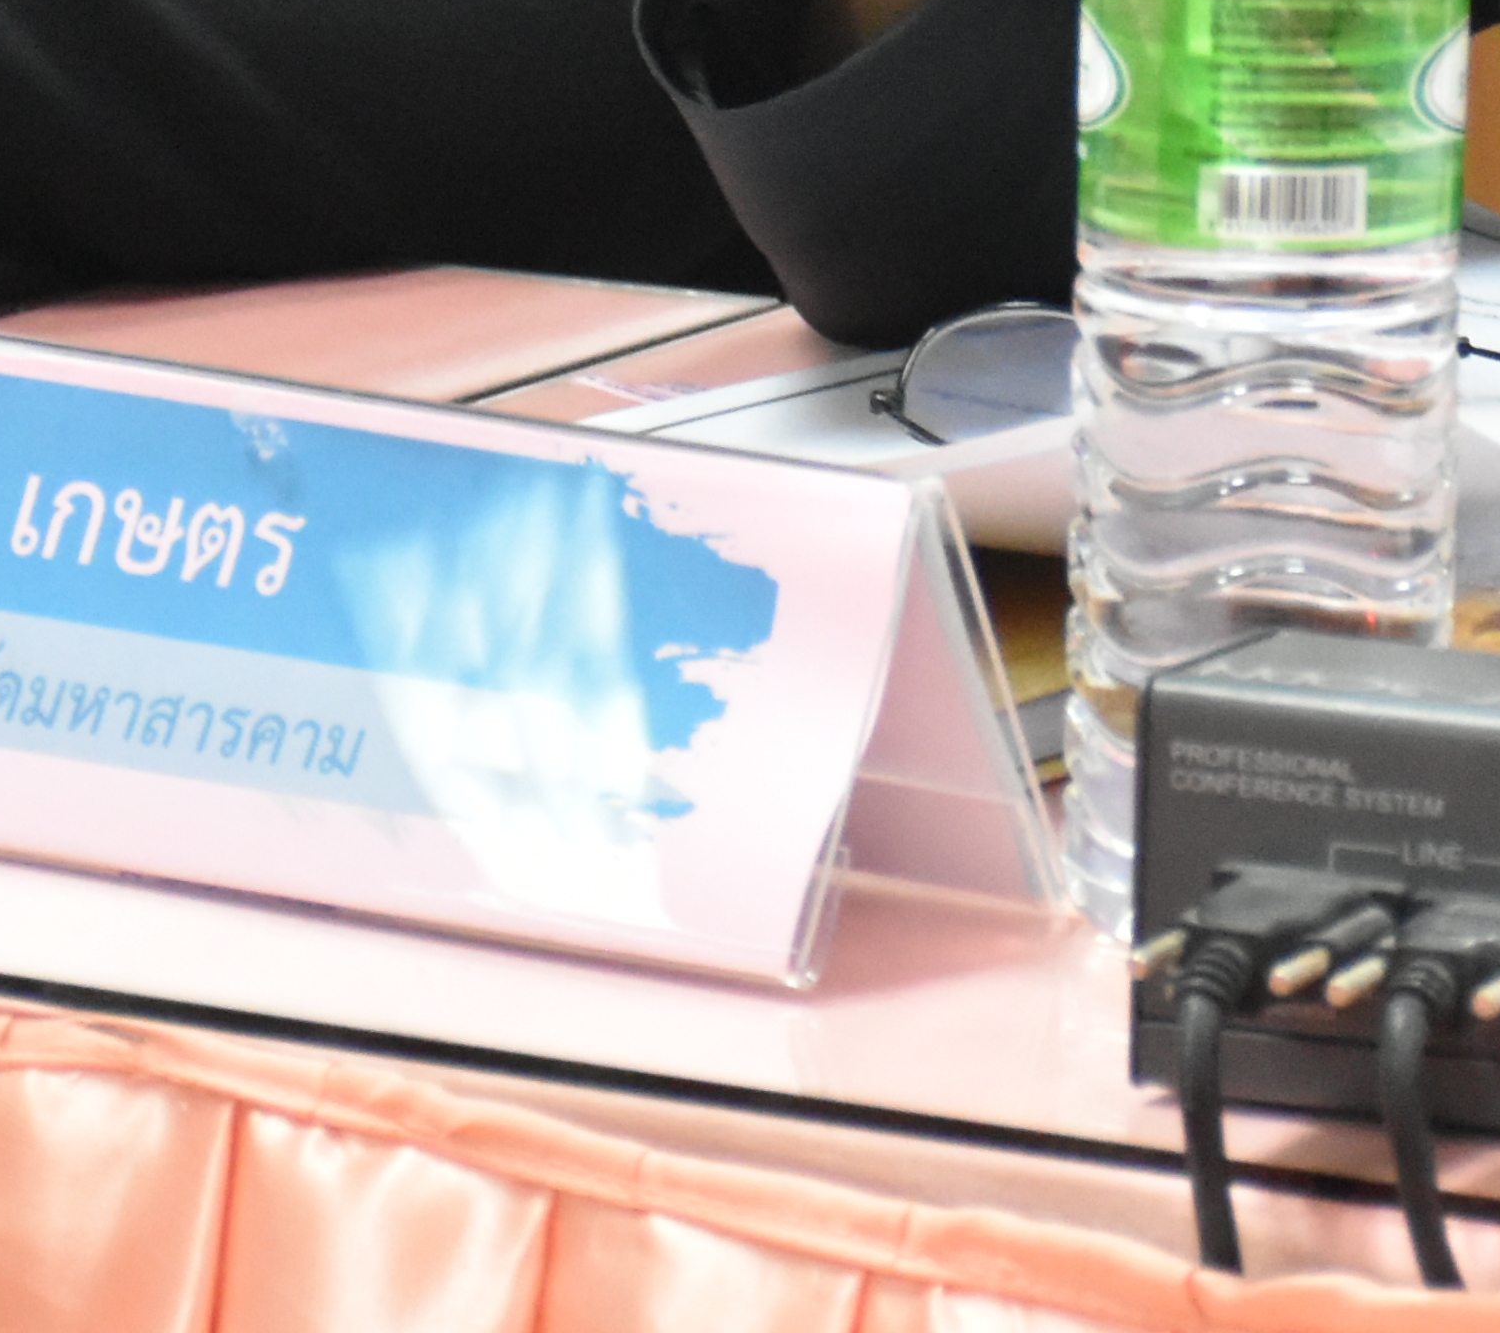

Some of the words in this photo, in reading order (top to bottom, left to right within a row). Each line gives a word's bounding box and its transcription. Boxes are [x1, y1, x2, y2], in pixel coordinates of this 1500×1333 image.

[11, 473, 307, 597] เกษตร
[1170, 741, 1355, 781] PROFESSIONAL
[1170, 768, 1338, 809] CONFERENCE
[1345, 785, 1446, 819] SYSTEM
[1402, 840, 1465, 872] LINE
